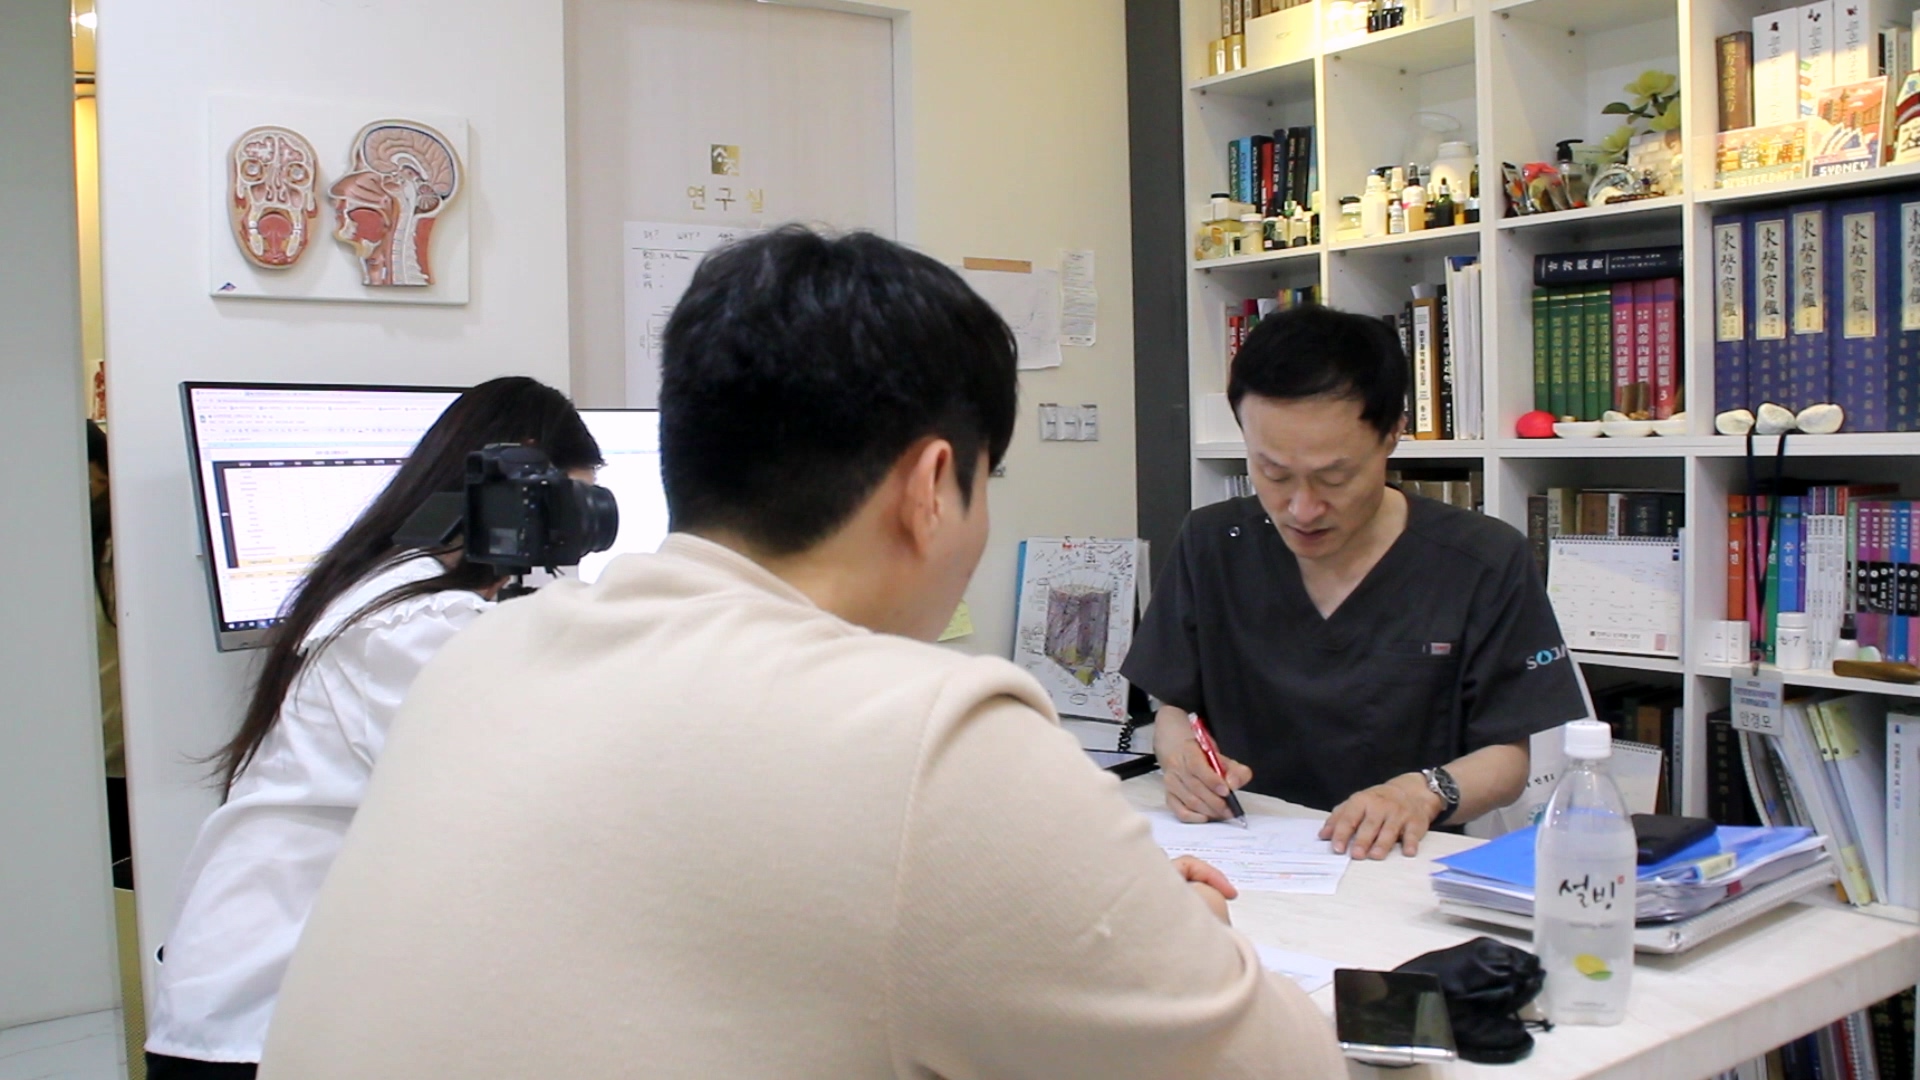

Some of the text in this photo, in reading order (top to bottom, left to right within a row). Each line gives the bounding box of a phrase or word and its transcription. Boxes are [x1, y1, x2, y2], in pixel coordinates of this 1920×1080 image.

[1819, 161, 1869, 177] SYDNEY
[687, 185, 764, 214] 연구실
[1659, 390, 1668, 401] 3
[1740, 710, 1772, 729] 안경모
[1559, 873, 1615, 911] 설빙
